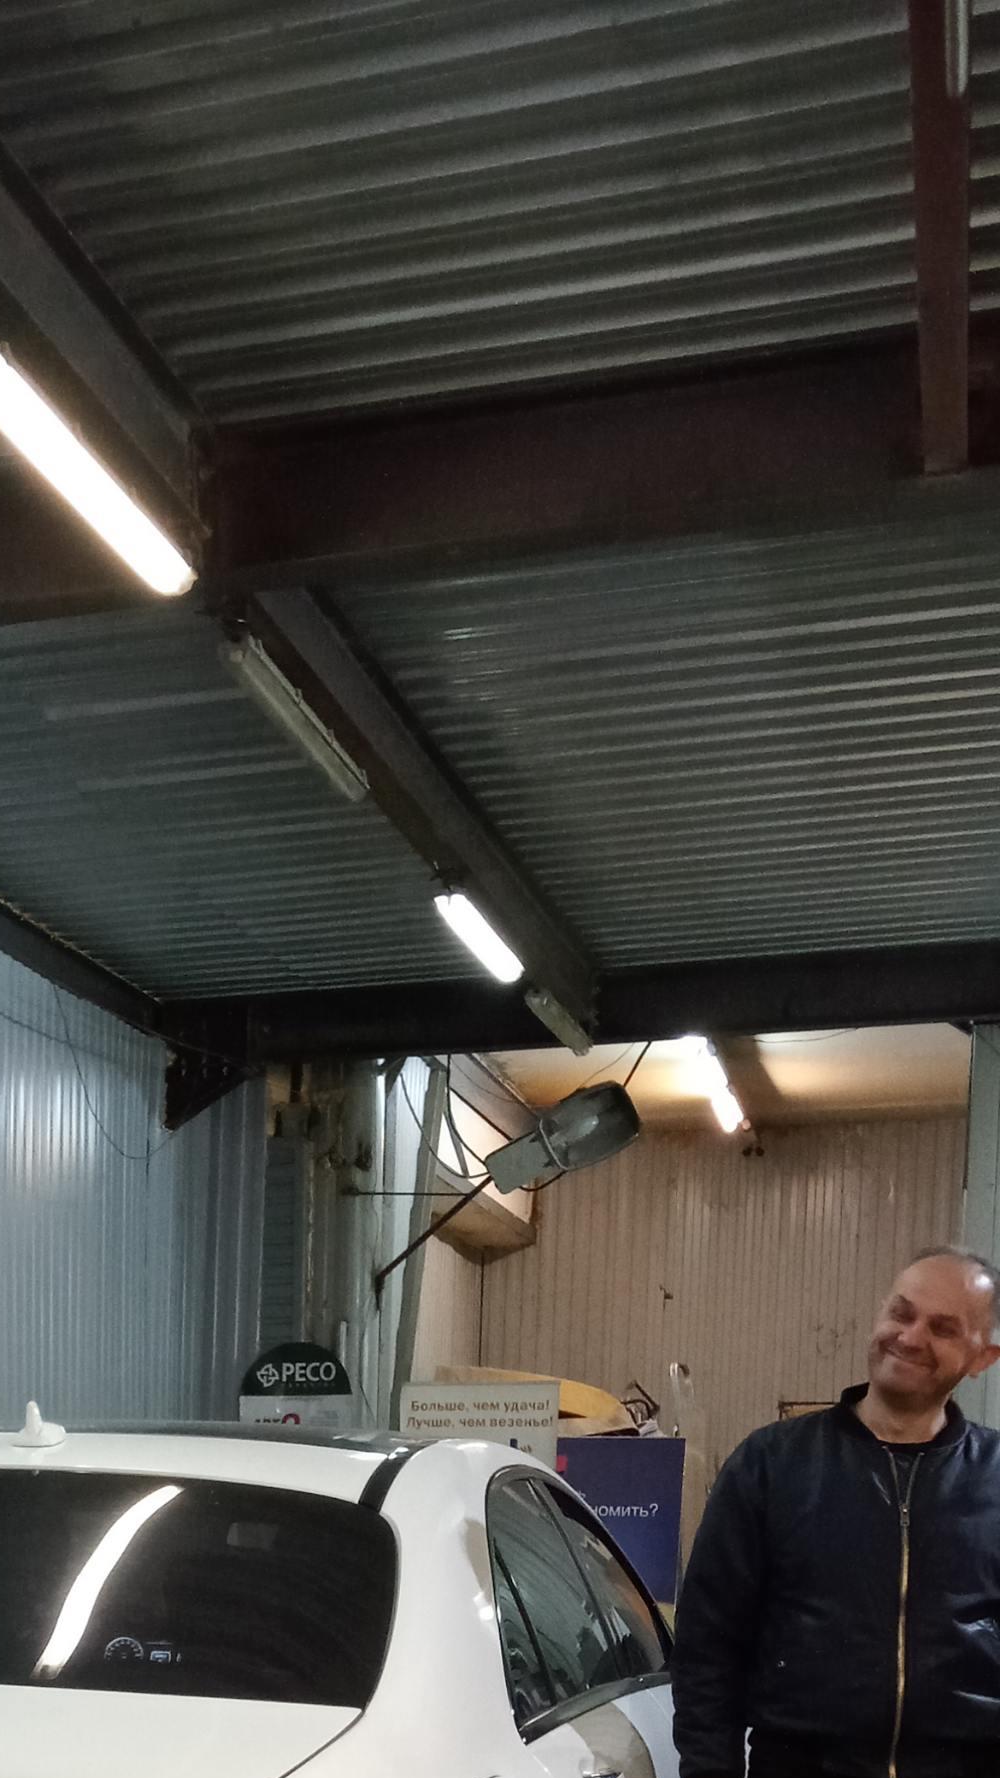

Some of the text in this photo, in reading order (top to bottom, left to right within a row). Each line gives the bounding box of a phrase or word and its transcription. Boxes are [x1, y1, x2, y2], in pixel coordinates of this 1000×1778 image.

[281, 1361, 337, 1382] РЕСО
[411, 1399, 550, 1413] Больше, чем удача!
[459, 1417, 486, 1427] чем
[490, 1416, 554, 1428] везенье!
